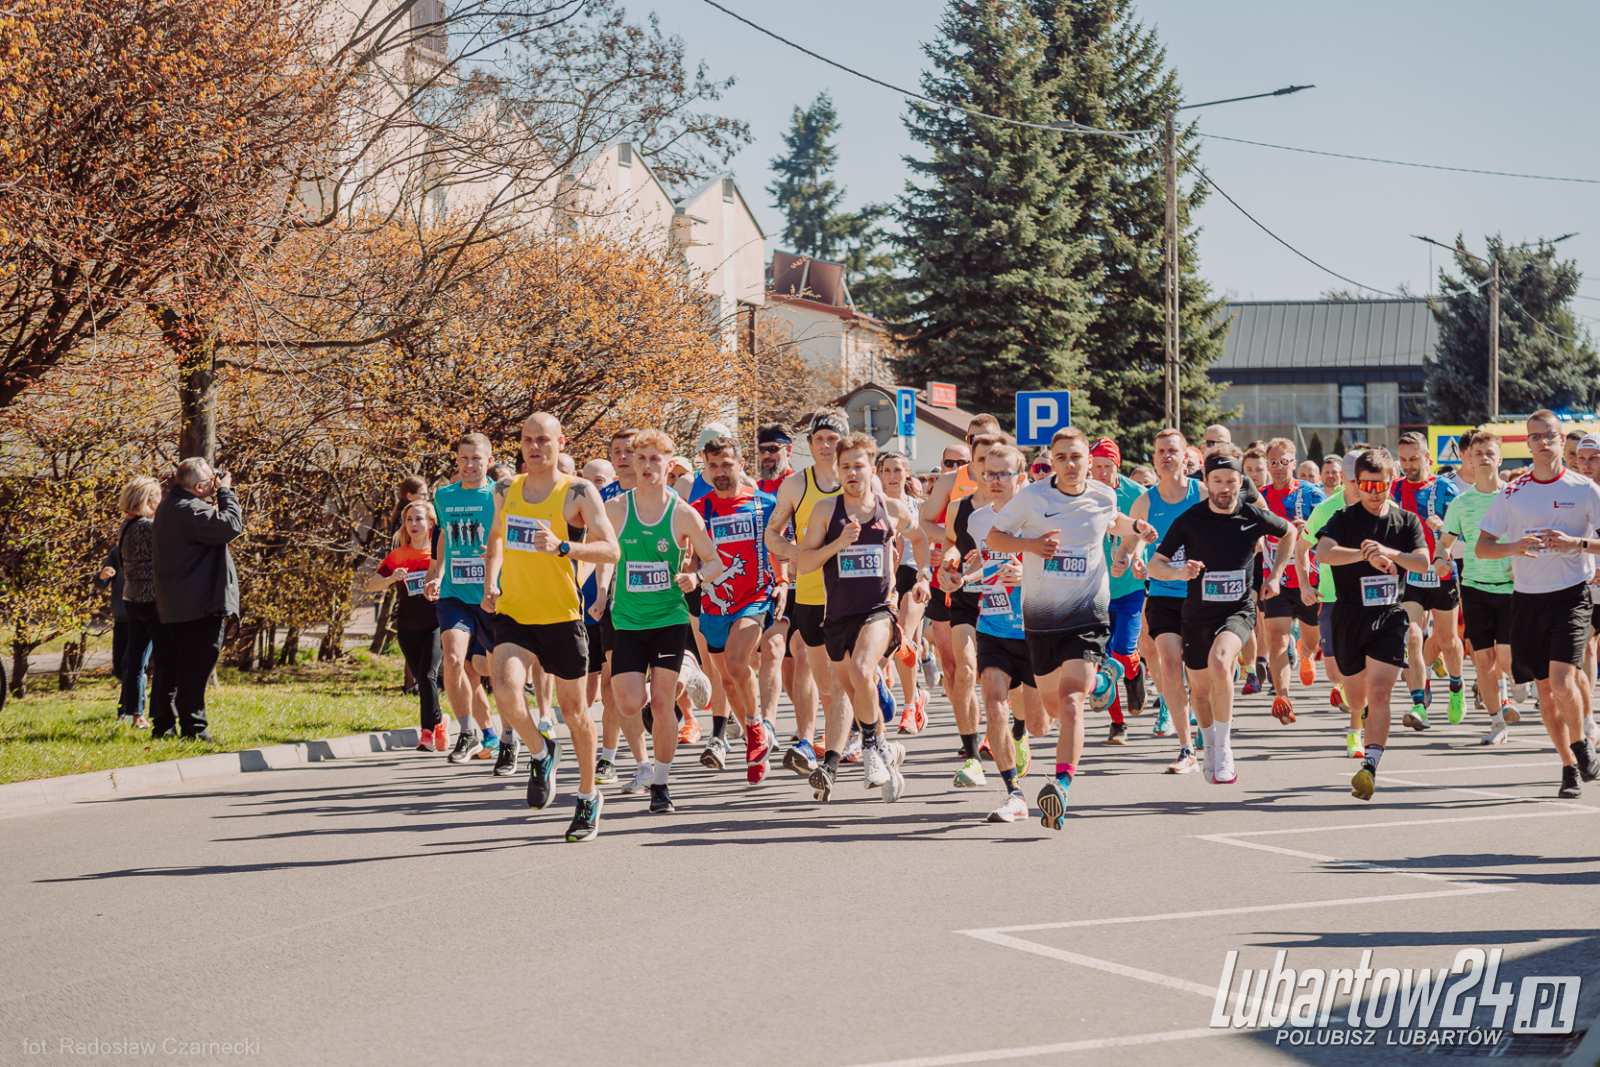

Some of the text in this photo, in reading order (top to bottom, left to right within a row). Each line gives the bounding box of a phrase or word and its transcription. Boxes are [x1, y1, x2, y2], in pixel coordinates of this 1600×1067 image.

[902, 394, 912, 422] P
[1029, 398, 1058, 439] P
[730, 521, 750, 533] 170
[858, 555, 880, 568] 139
[1062, 557, 1085, 571] 080
[465, 566, 484, 577] 169
[646, 571, 668, 584] 108
[1222, 581, 1242, 593] 123
